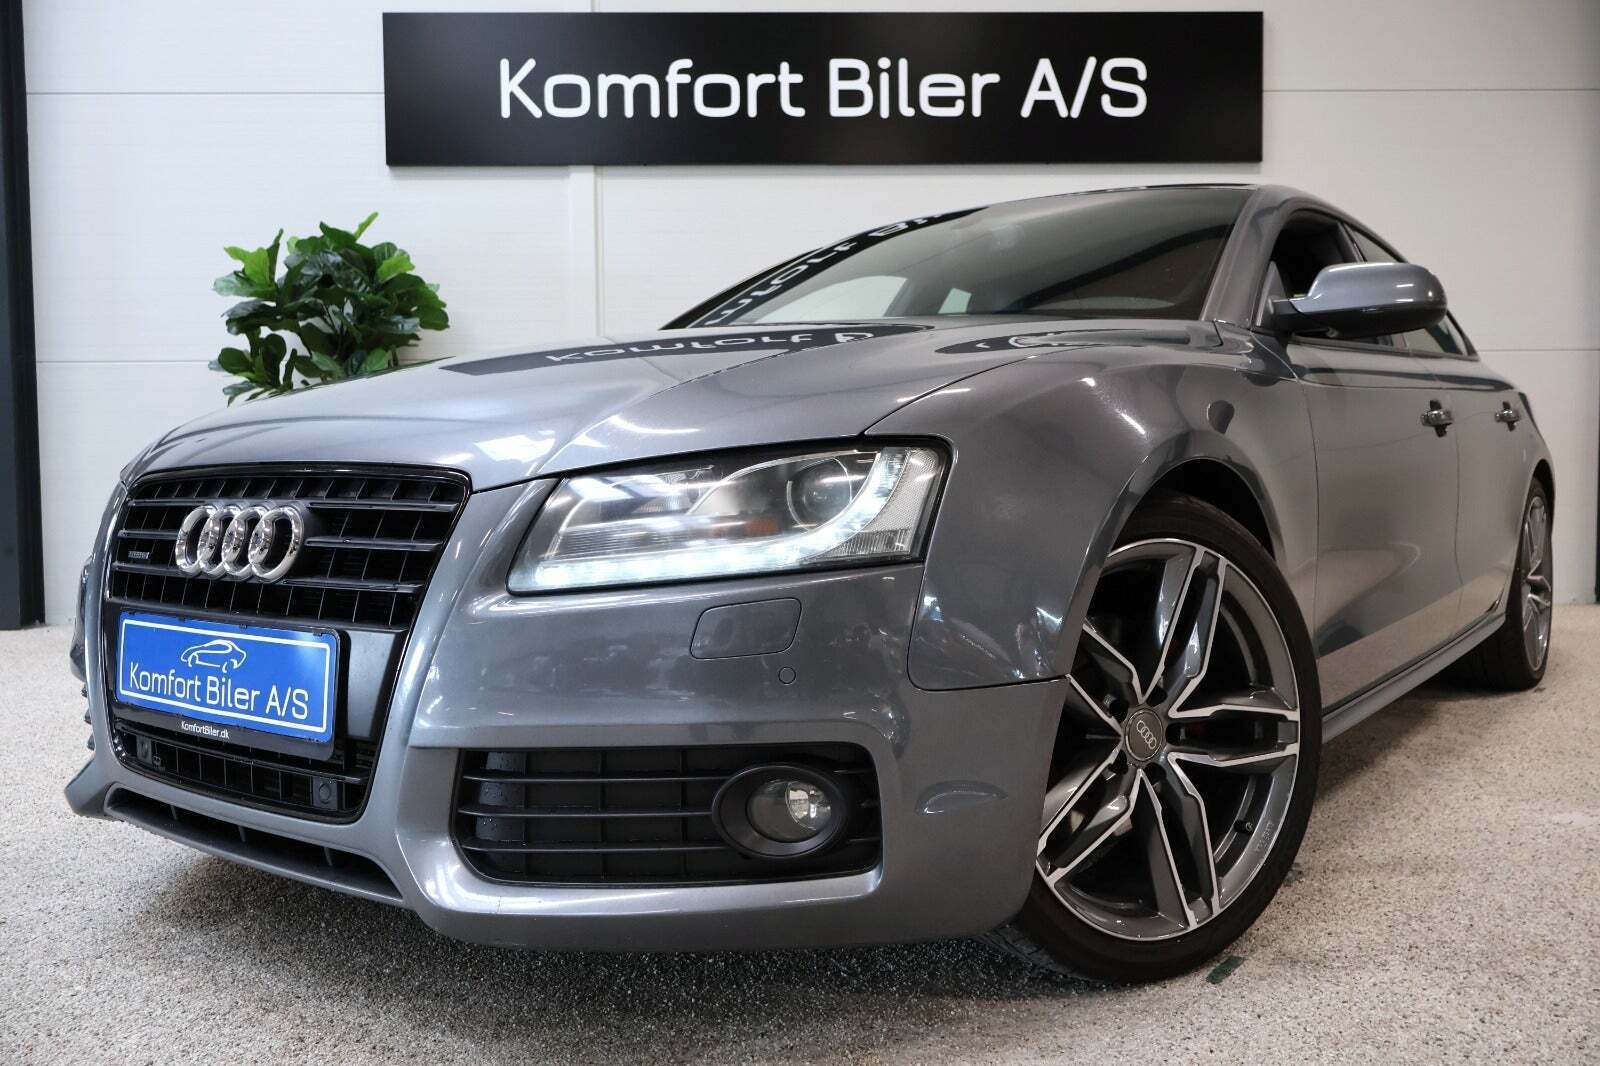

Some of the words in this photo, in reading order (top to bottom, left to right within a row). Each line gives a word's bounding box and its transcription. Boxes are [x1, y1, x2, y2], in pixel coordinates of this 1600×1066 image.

[499, 57, 806, 120] Komfort
[828, 57, 1001, 119] Biler
[1020, 57, 1148, 119] A/S
[129, 661, 201, 701] Komfort
[207, 675, 260, 711] Biler
[265, 684, 309, 720] A/S
[181, 720, 229, 739] KomfortBiler.dk
